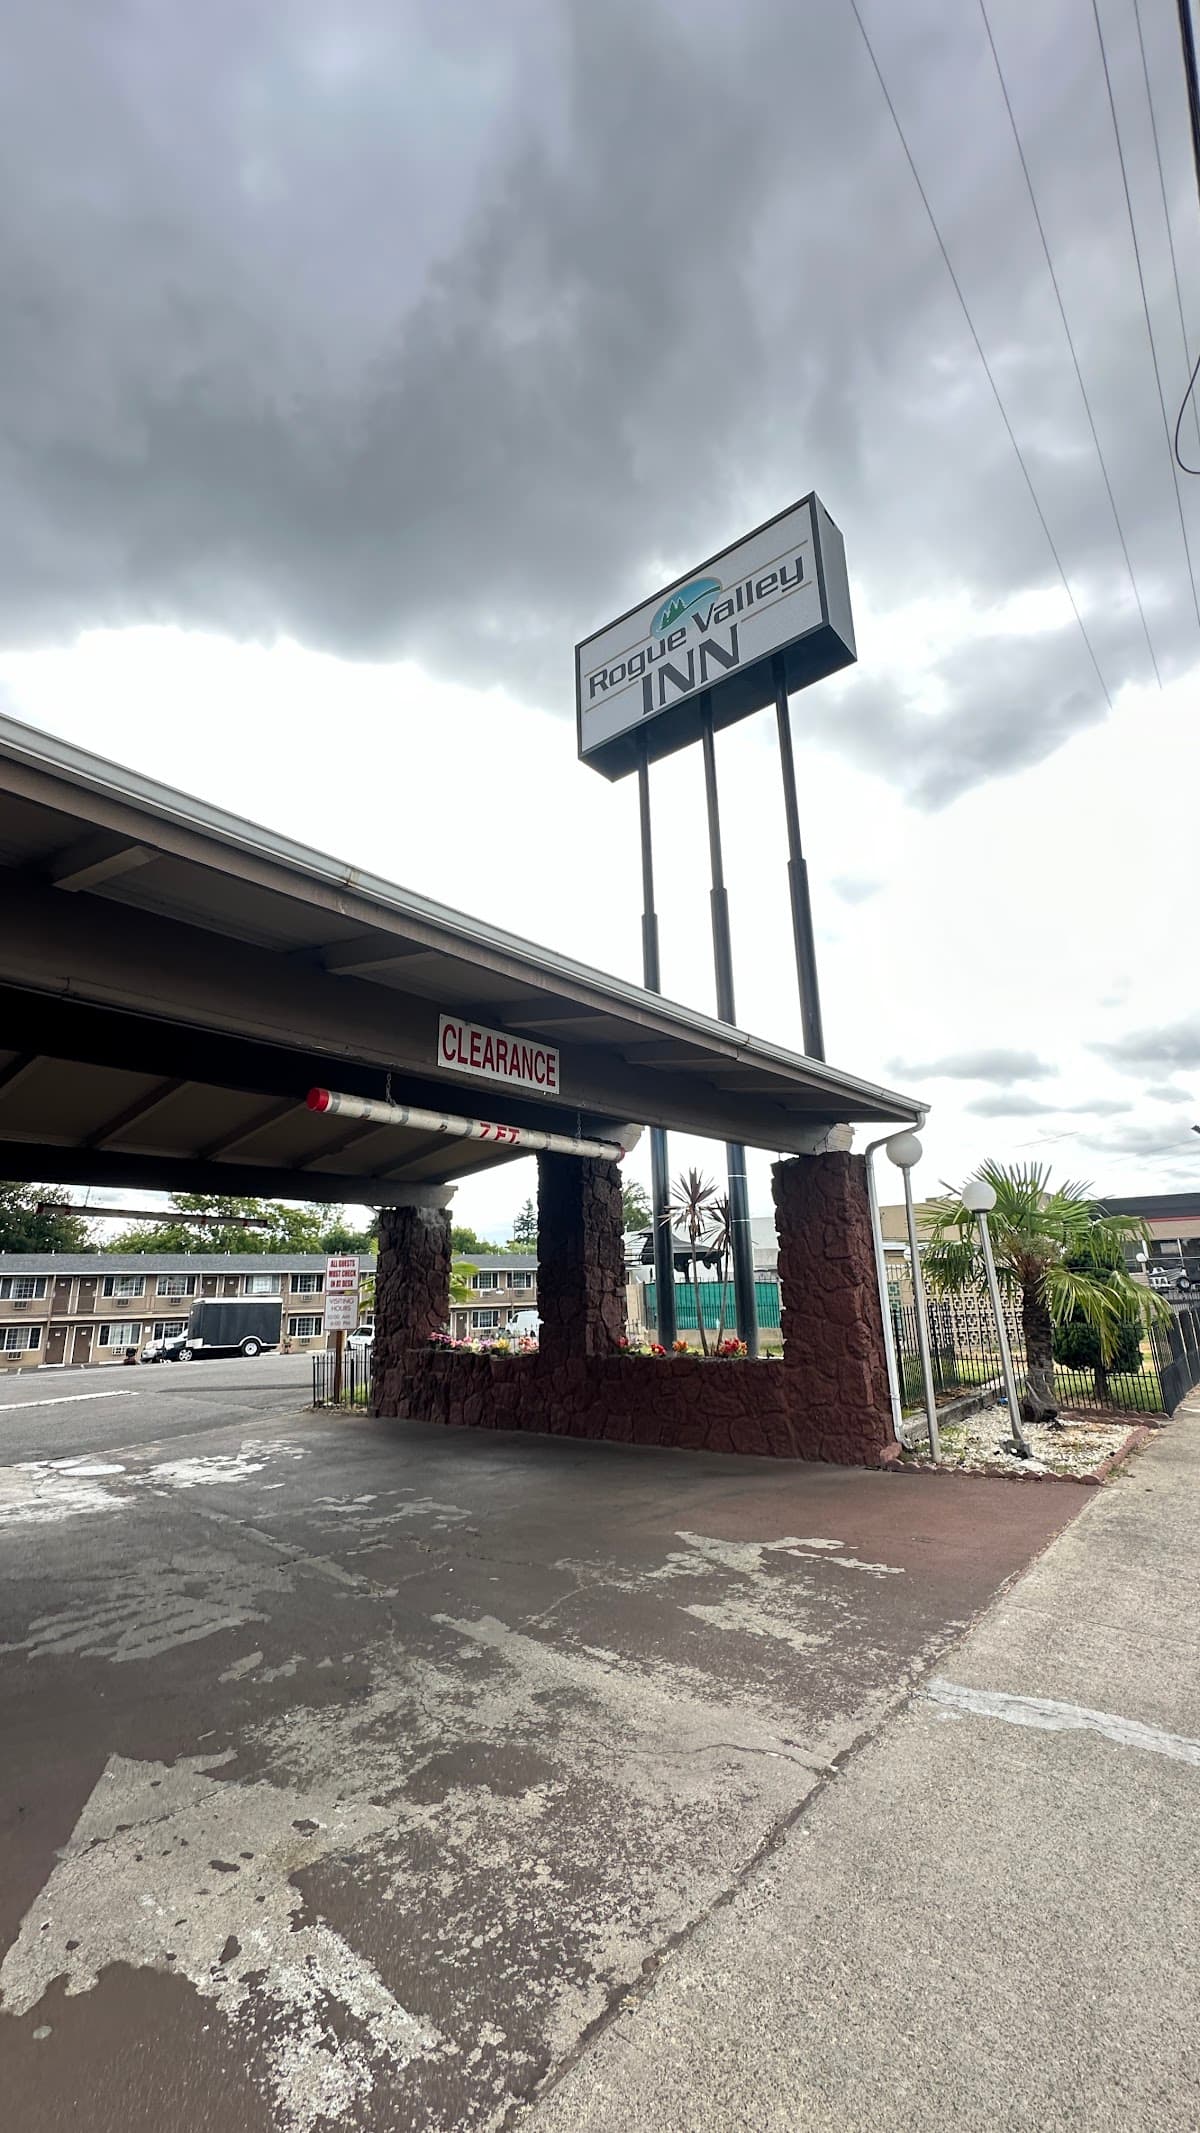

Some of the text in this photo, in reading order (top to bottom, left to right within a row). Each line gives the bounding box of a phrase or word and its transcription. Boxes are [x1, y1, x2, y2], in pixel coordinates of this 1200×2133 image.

[589, 557, 804, 699] Rogue Valley
[642, 623, 740, 715] INN
[442, 1023, 556, 1086] CLEARANCE
[480, 1122, 520, 1144] 7 FT.
[339, 1259, 355, 1267] GUESTS
[329, 1270, 356, 1278] MUST CHECK
[331, 1280, 353, 1288] IN AT DESK
[329, 1297, 355, 1305] VISITING
[331, 1304, 352, 1312] HOURS
